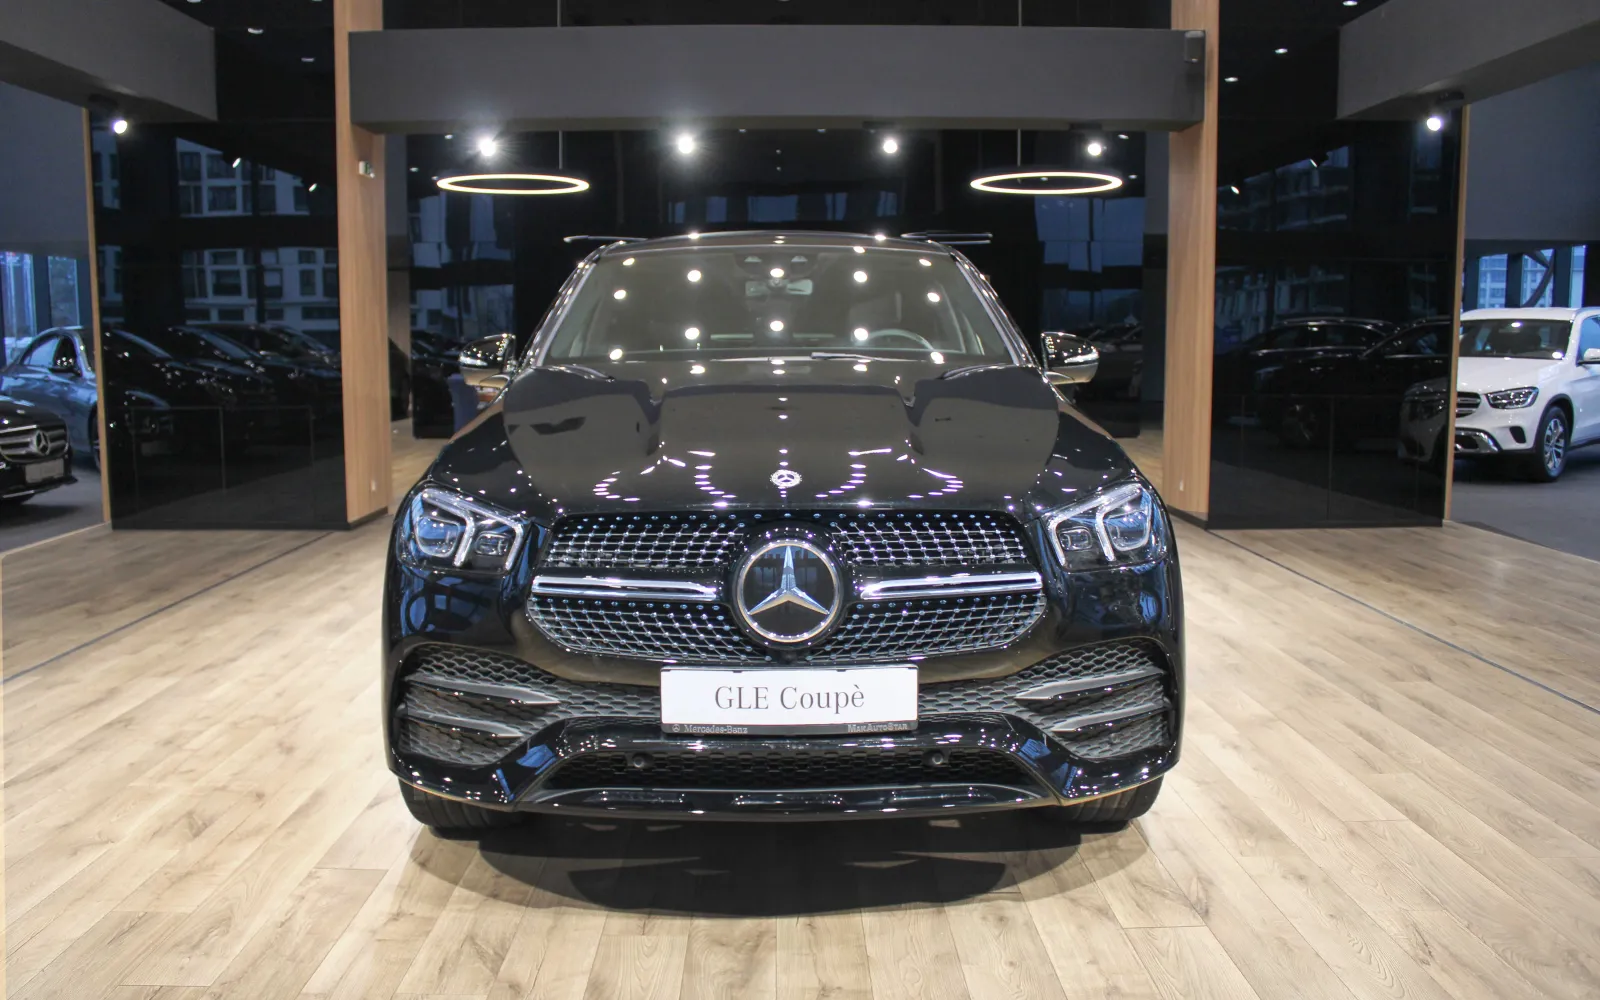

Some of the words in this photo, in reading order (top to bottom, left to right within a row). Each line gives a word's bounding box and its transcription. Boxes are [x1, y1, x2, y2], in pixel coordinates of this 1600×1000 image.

[715, 685, 769, 710] GLE
[780, 684, 865, 715] Coupè
[684, 724, 748, 734] Mercedes-Benz
